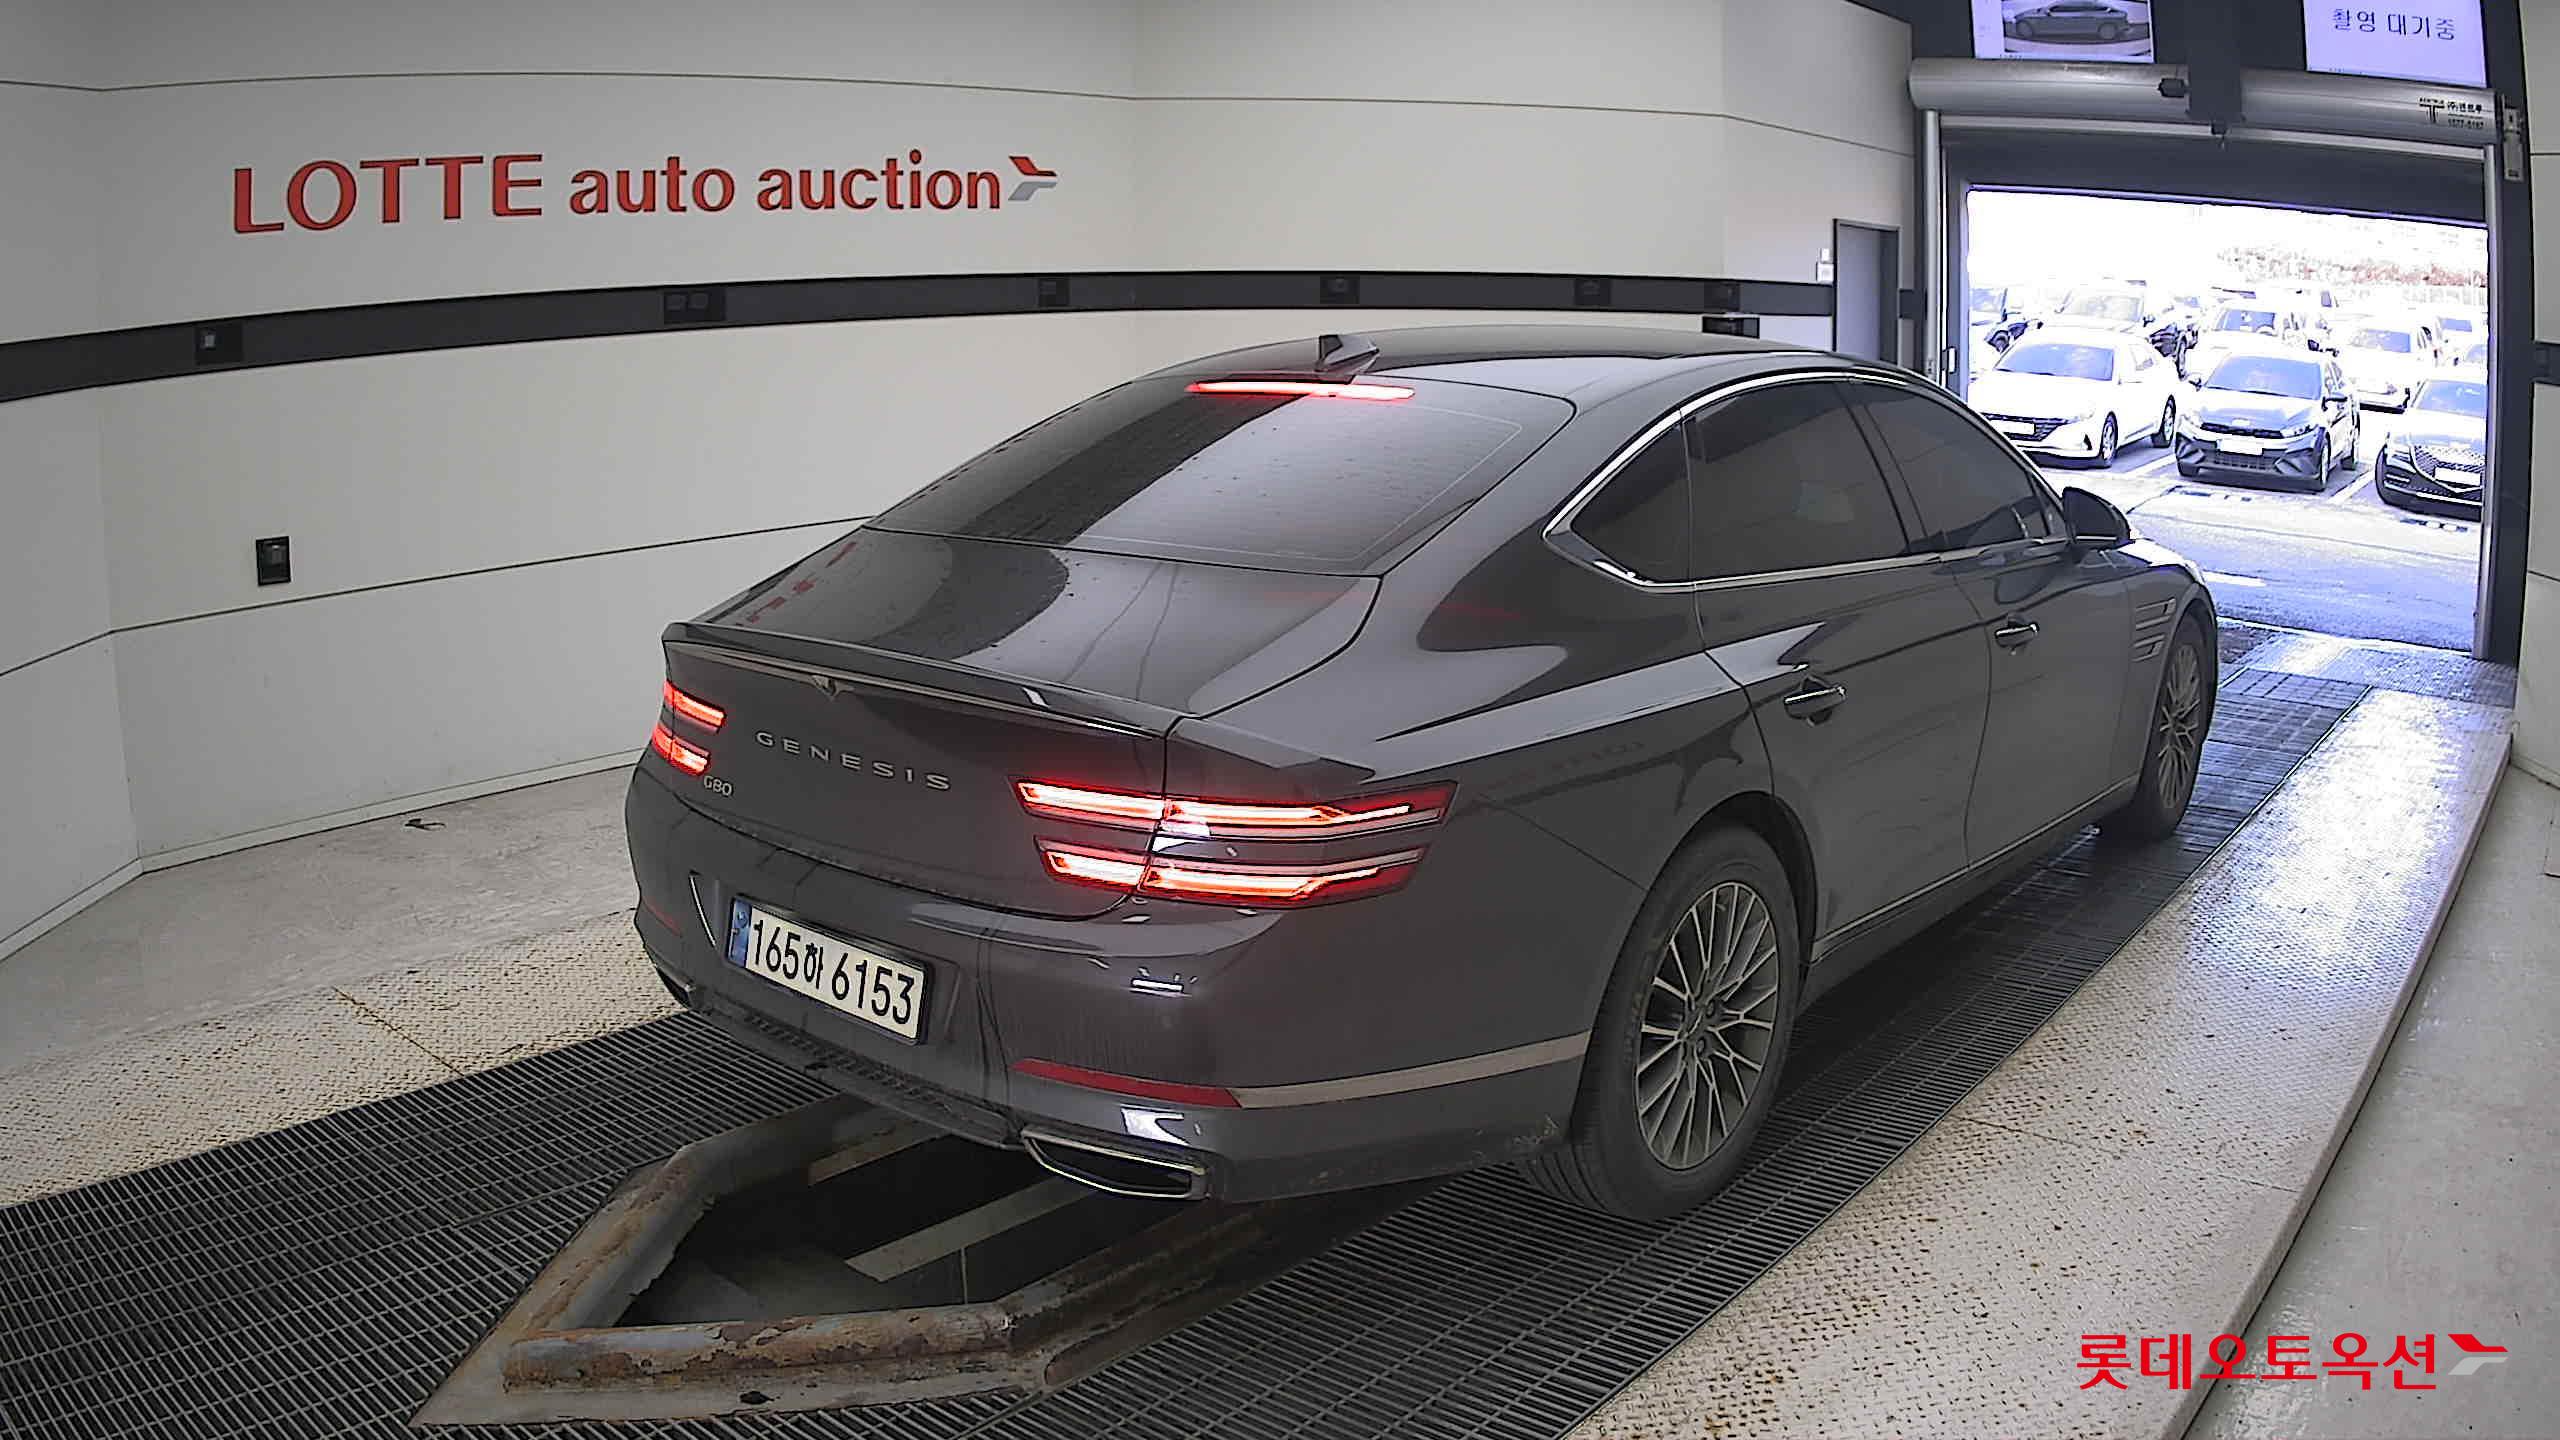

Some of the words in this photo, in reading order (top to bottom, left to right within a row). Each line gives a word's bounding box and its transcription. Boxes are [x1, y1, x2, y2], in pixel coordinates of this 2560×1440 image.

[2333, 8, 2376, 33] 촬영
[2387, 13, 2456, 41] 대기중
[234, 155, 540, 232] LOTTE
[570, 158, 735, 213] auto
[756, 151, 1002, 209] auction
[702, 775, 735, 797] G80
[755, 731, 951, 791] GENESIS
[753, 919, 825, 990] 165하
[831, 952, 916, 1026] 6153
